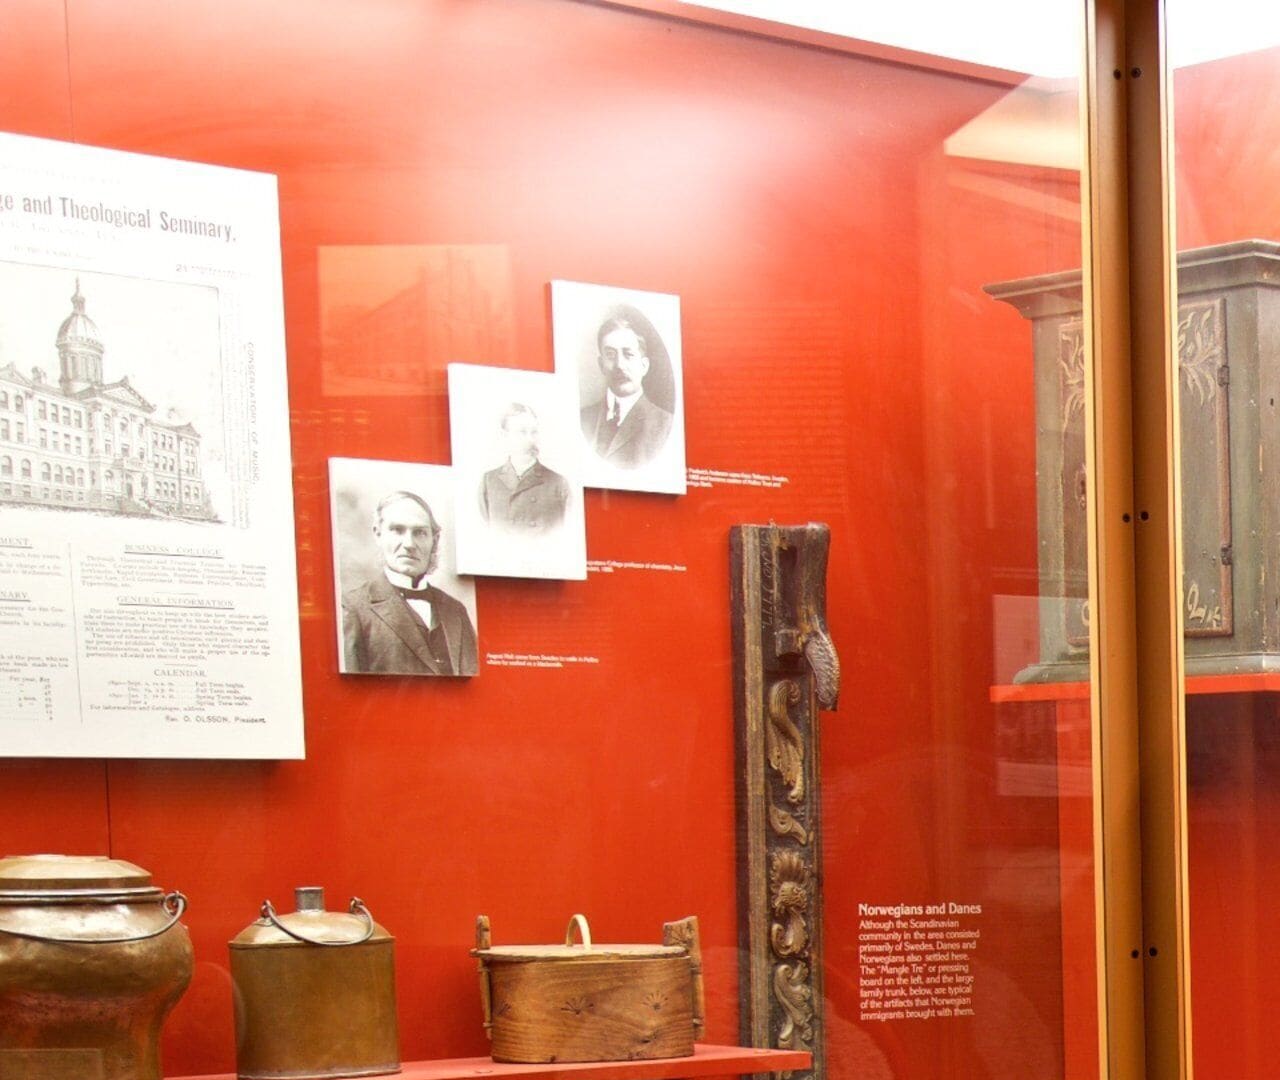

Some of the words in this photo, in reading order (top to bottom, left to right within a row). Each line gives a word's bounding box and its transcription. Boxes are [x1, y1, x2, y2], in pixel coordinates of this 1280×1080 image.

[22, 195, 52, 216] and
[58, 197, 152, 231] Theological
[859, 904, 923, 918] Norwegians
[925, 903, 945, 914] and
[949, 902, 981, 914] Danes
